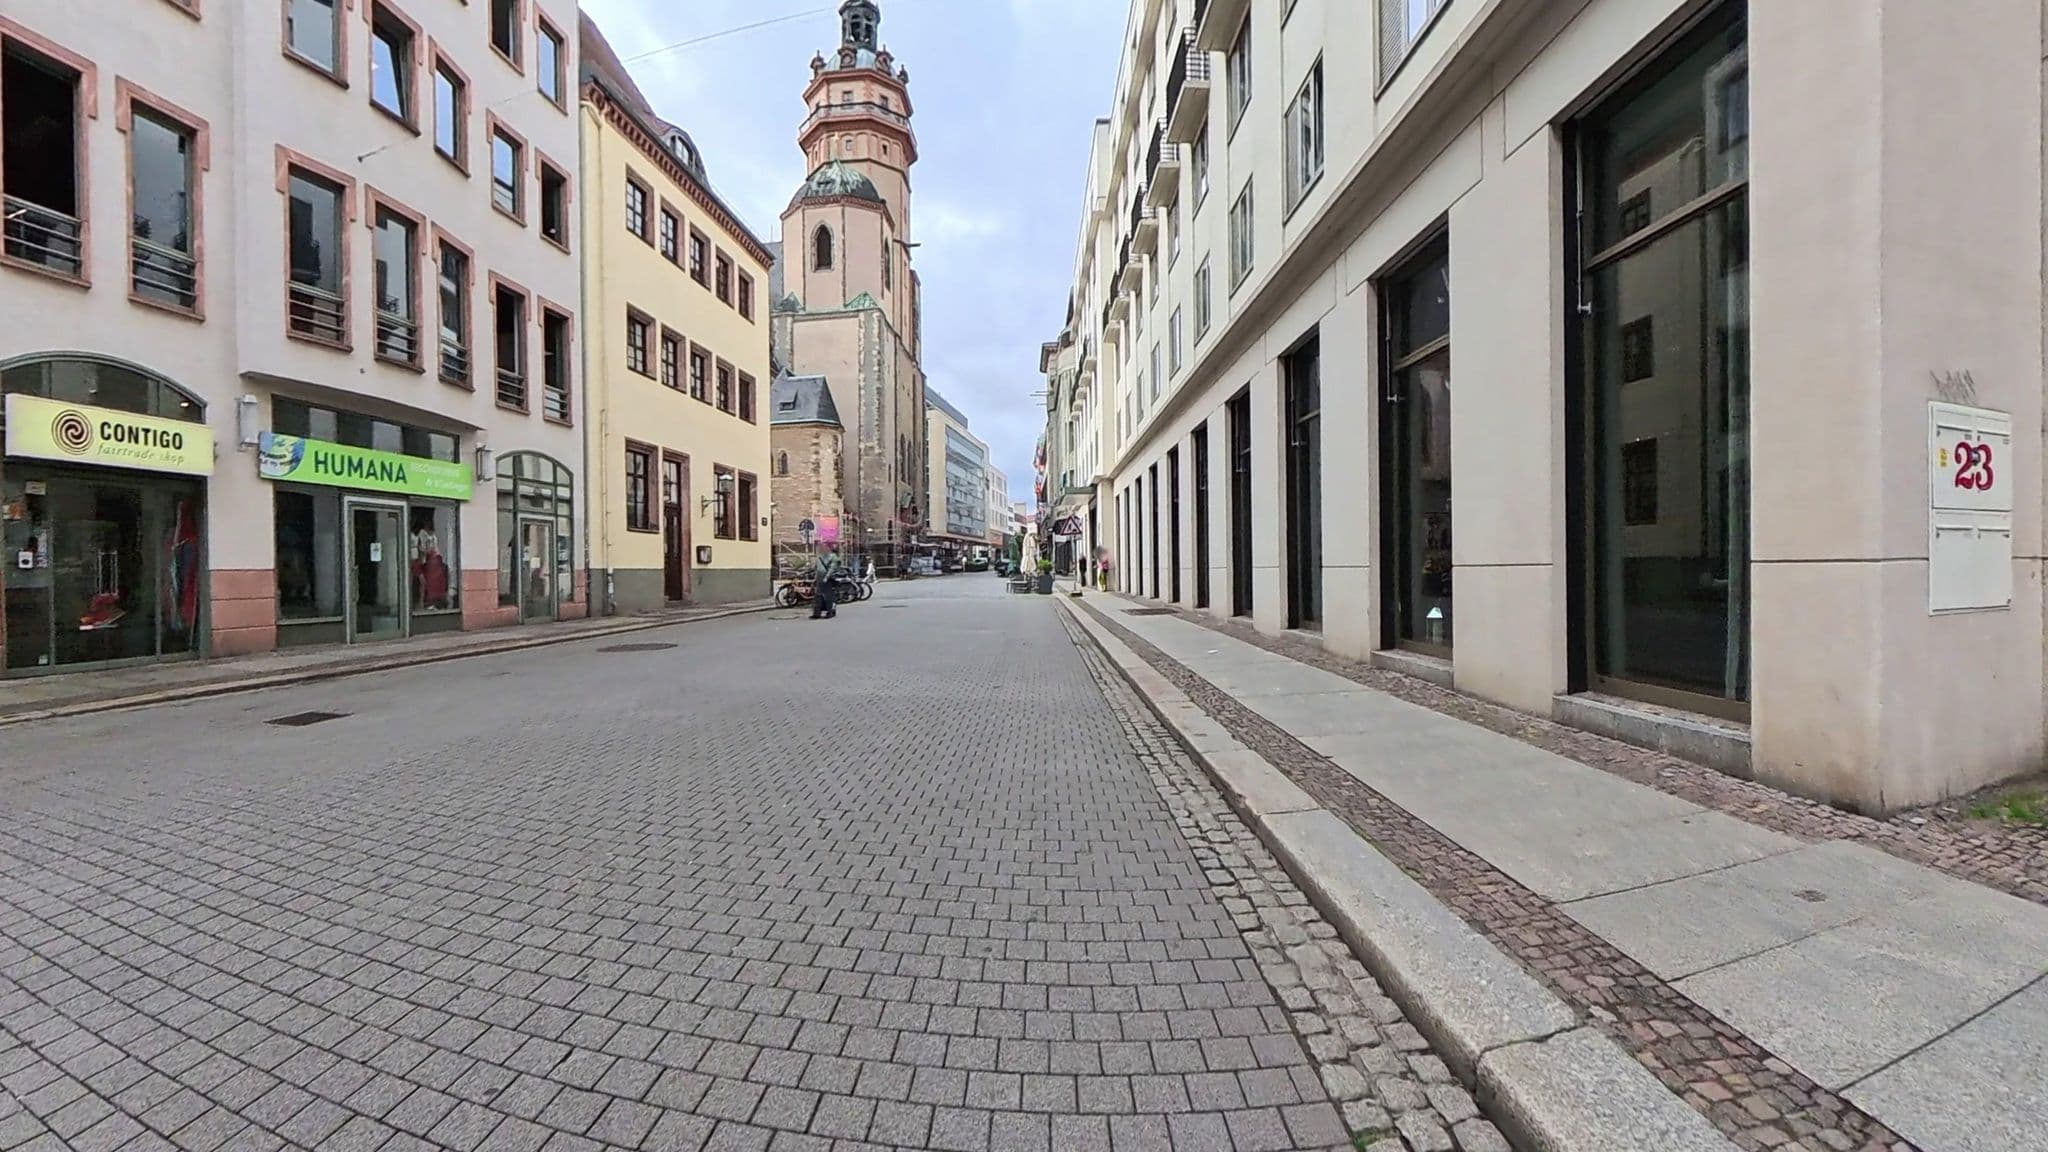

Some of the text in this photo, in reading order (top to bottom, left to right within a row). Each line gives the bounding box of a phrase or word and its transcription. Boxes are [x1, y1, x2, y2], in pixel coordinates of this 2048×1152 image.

[101, 422, 183, 450] CONTIGO
[97, 444, 154, 460] fairtrade
[314, 450, 407, 484] HUMANA
[1954, 441, 1994, 491] 23
